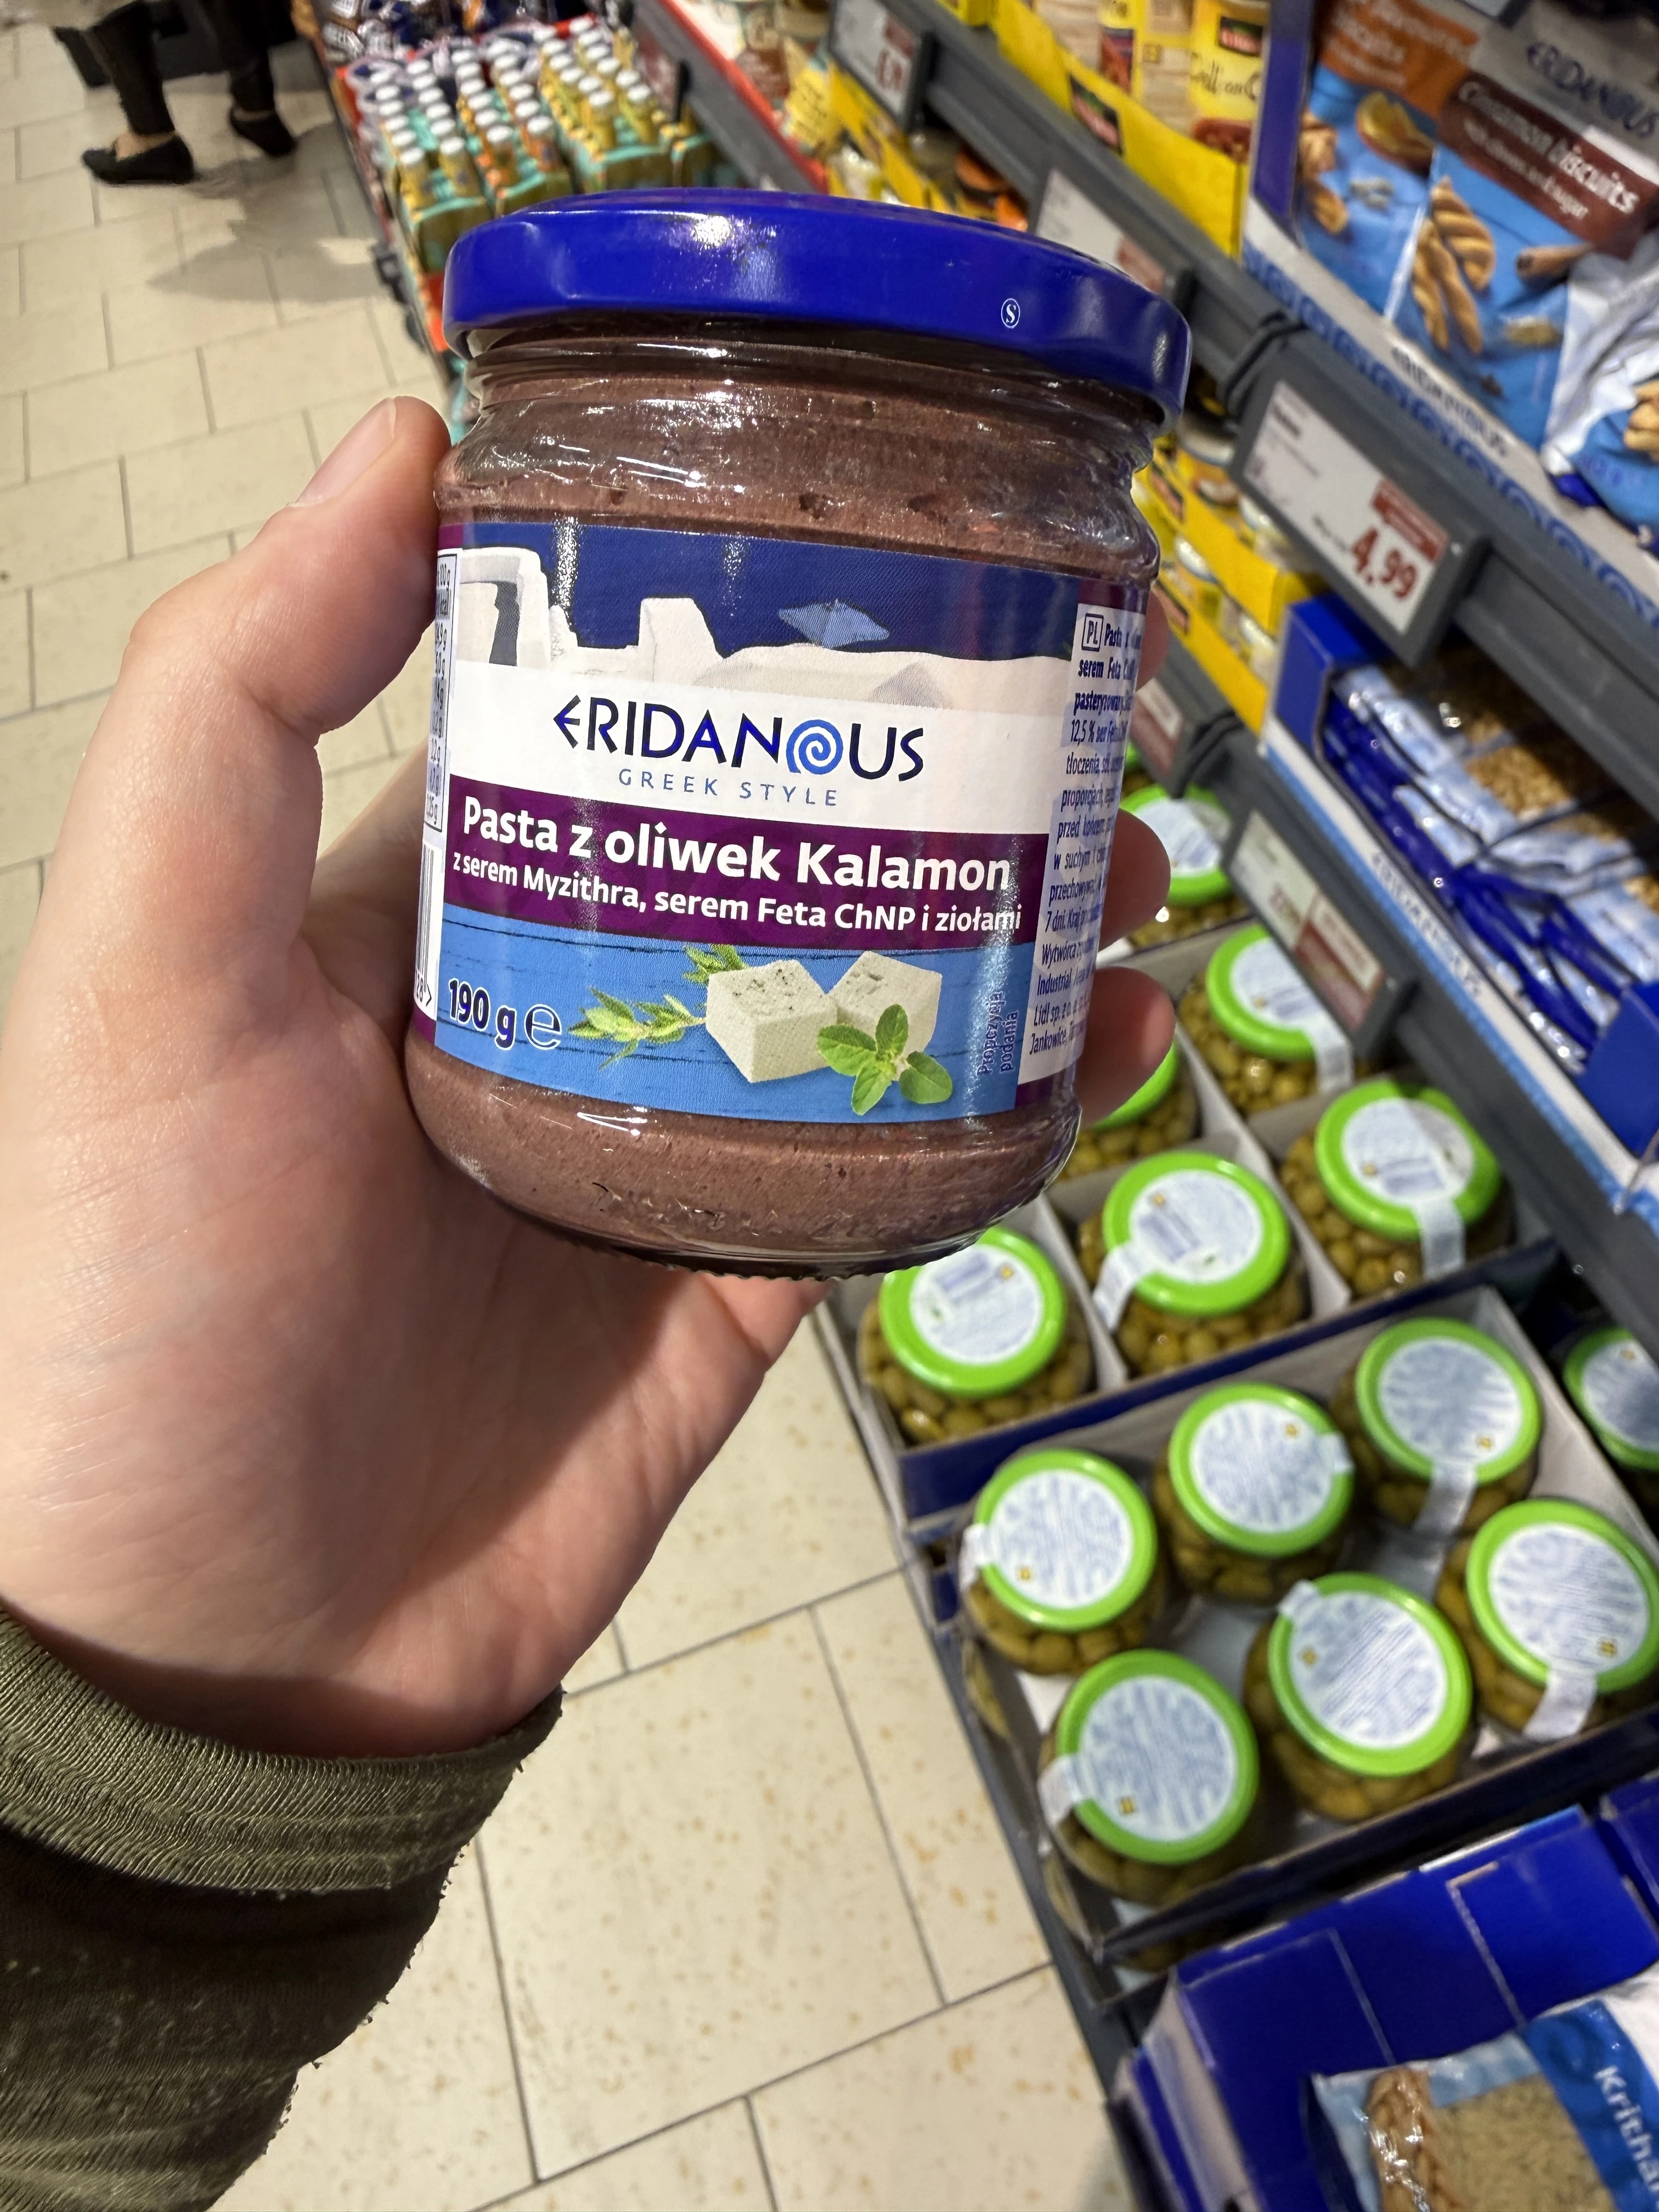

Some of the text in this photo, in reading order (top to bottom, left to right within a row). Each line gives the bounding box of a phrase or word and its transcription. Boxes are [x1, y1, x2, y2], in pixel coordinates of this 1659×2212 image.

[1078, 659, 1104, 678] serem
[553, 695, 924, 782] ERIDANOUS
[1070, 719, 1087, 746] 12,5
[618, 768, 837, 807] GREEK STYLE
[464, 795, 558, 853] Pasta
[568, 823, 594, 859] z
[605, 821, 782, 882] oliwek
[797, 842, 1011, 891] Kalamon
[1057, 814, 1081, 845] przed
[1053, 853, 1061, 870] w
[453, 851, 1022, 932] z serem Myzithra, serem Feta ChNP i ziołami
[1045, 911, 1052, 933] 7
[448, 977, 491, 1032] 190
[494, 1005, 517, 1051] g
[1034, 1002, 1050, 1026] Lidl
[999, 1010, 1019, 1074] podania
